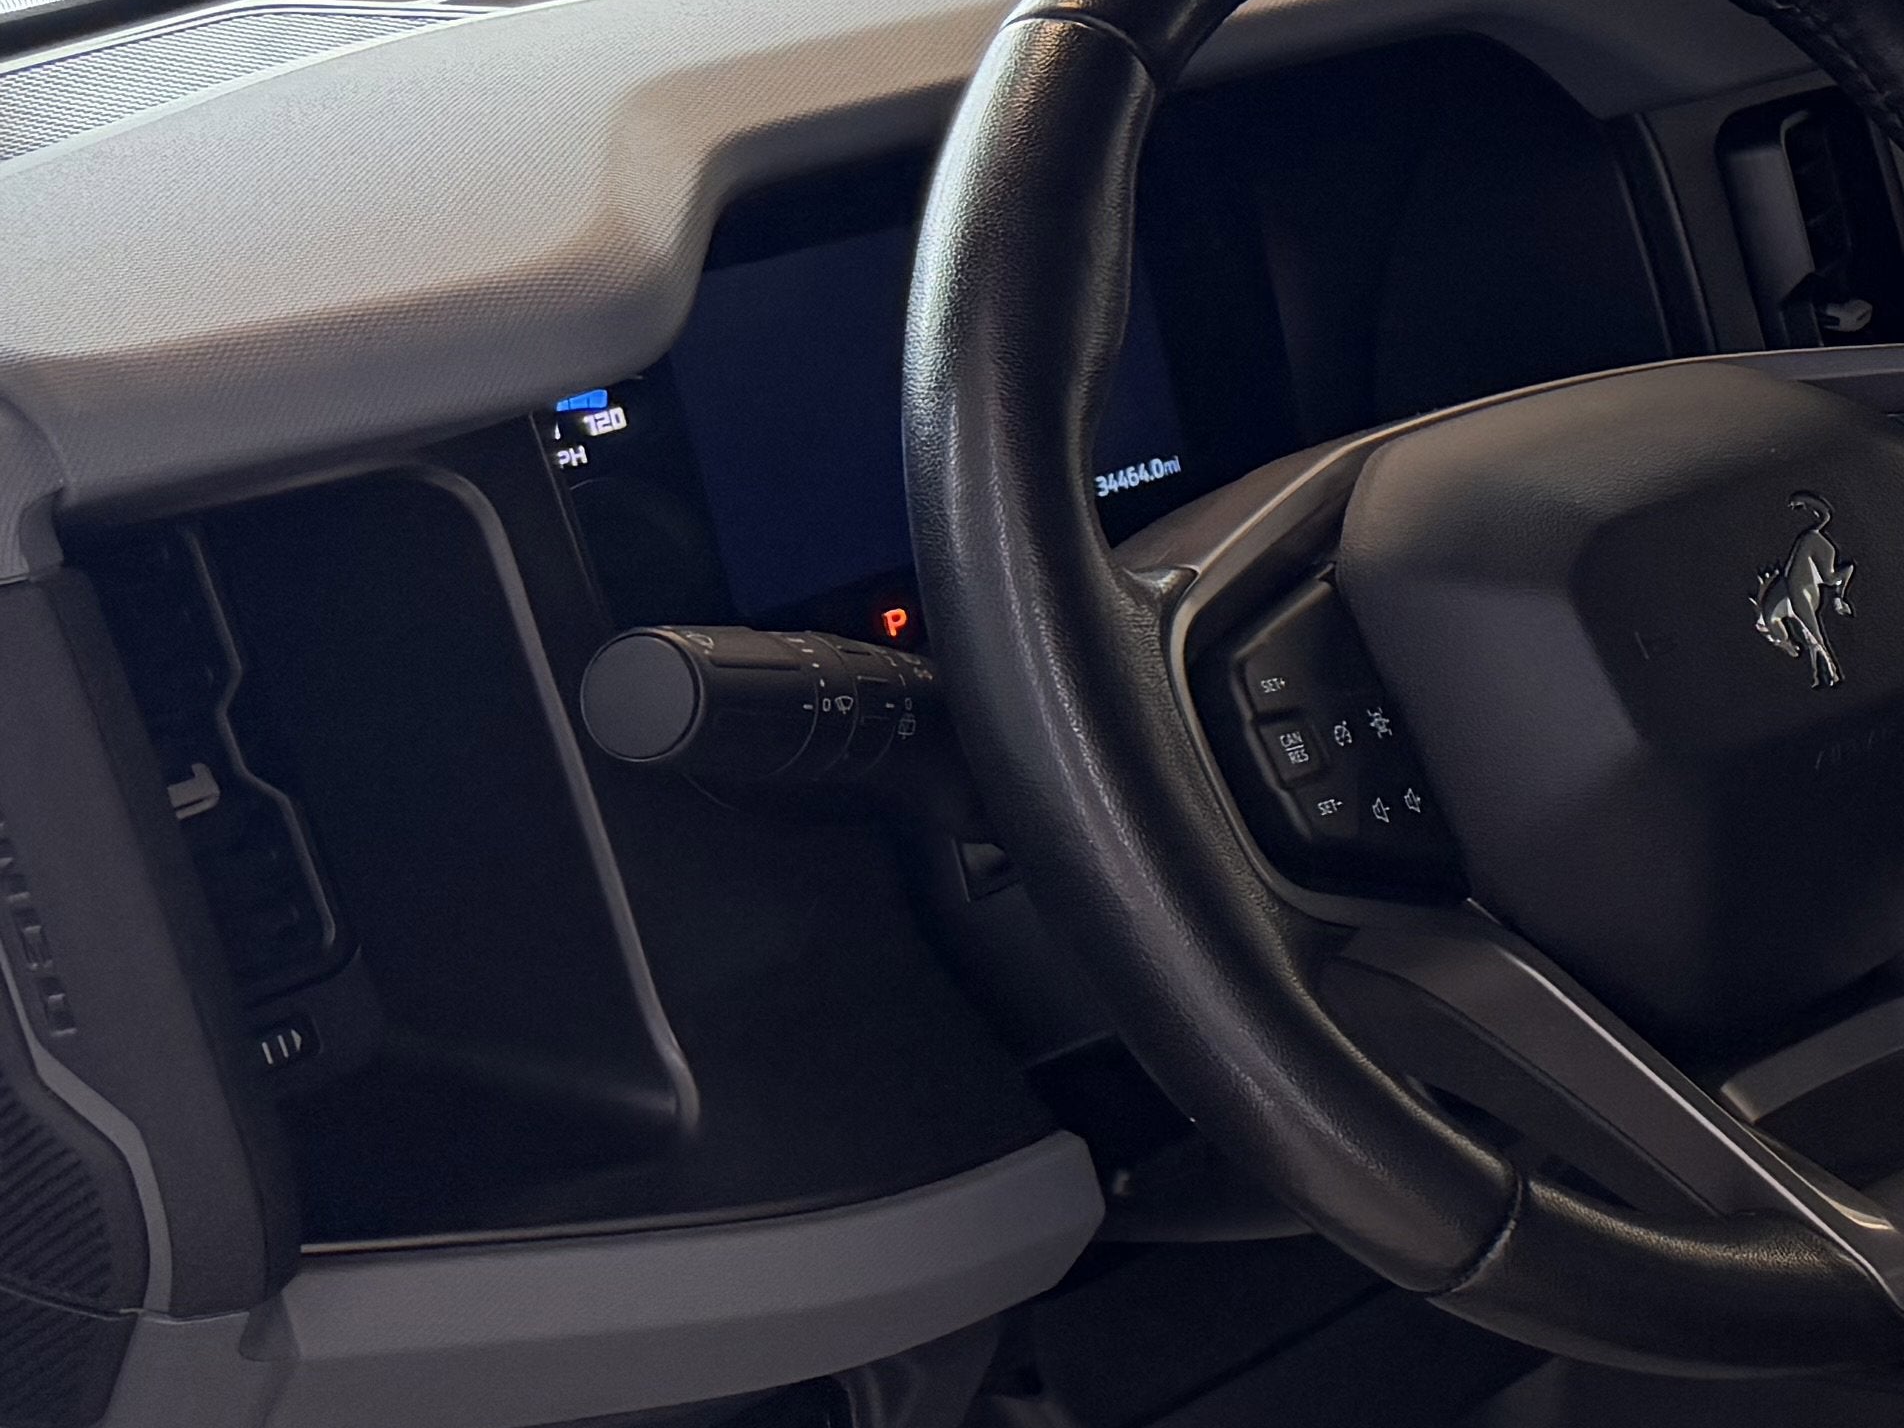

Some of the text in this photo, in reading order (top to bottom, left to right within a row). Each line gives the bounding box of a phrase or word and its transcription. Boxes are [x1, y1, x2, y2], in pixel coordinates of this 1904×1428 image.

[583, 406, 628, 436] 120
[882, 607, 908, 637] P
[1279, 731, 1304, 748] CAN
